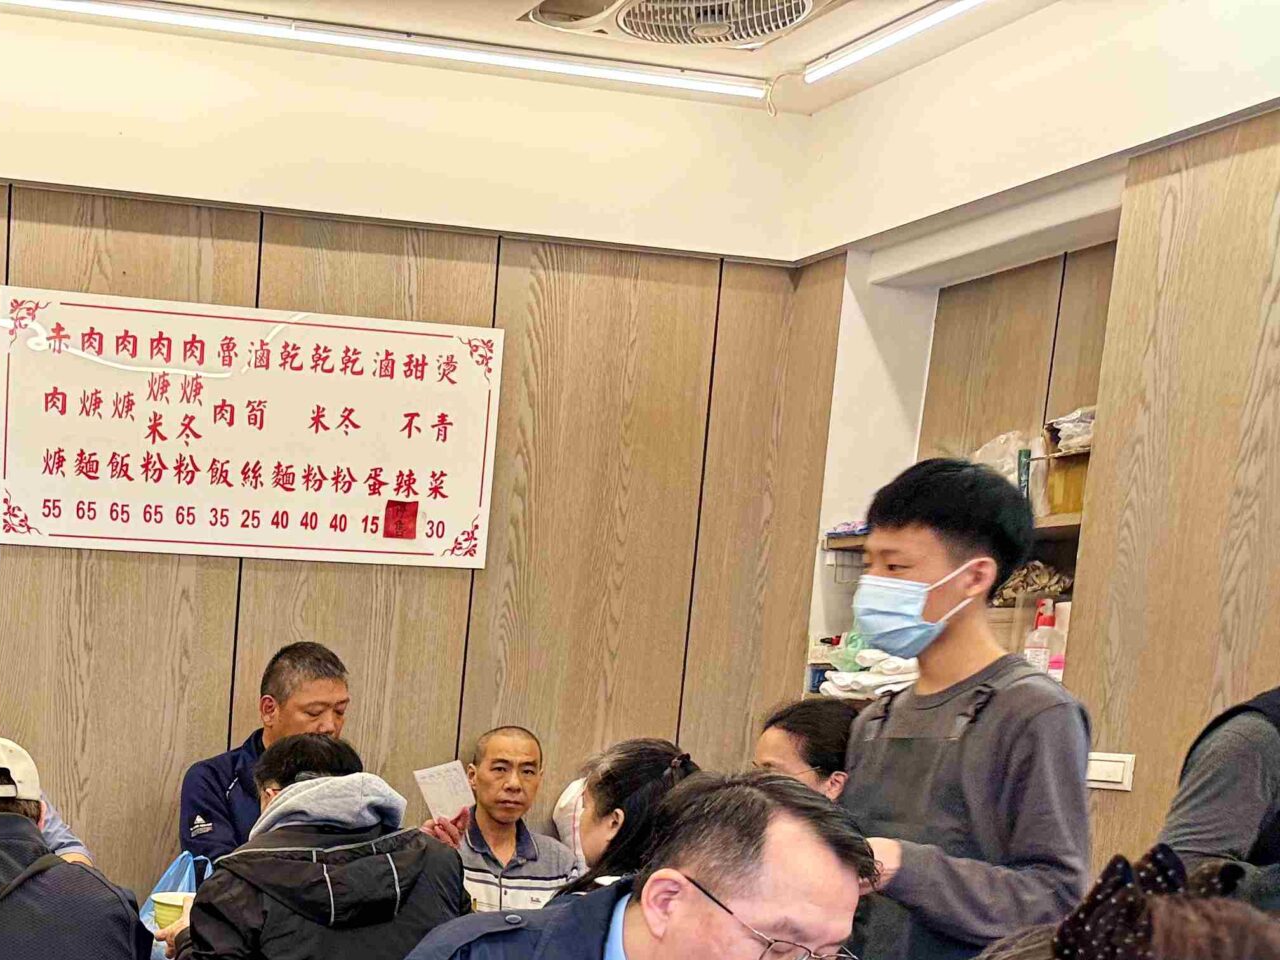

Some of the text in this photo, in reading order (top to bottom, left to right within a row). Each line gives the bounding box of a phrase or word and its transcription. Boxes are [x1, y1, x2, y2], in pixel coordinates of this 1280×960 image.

[42, 322, 70, 518] 赤肉焿 55
[75, 327, 104, 521] 肉焿麵 65
[108, 329, 138, 523] 肉焿飯 65
[141, 330, 173, 524] 肉焿米粉 65
[173, 334, 205, 525] 肉焿冬粉 65
[208, 336, 238, 528] 魯肉飯 35
[240, 339, 271, 529] 滷筍絲 25
[270, 341, 305, 529] 乾麵 40
[299, 344, 334, 530] 乾米粉 40
[329, 345, 364, 533] 乾冬粉 40
[362, 348, 396, 534] 滷蛋 15
[393, 353, 429, 498] 甜不辣
[424, 356, 457, 539] 燙青菜 30
